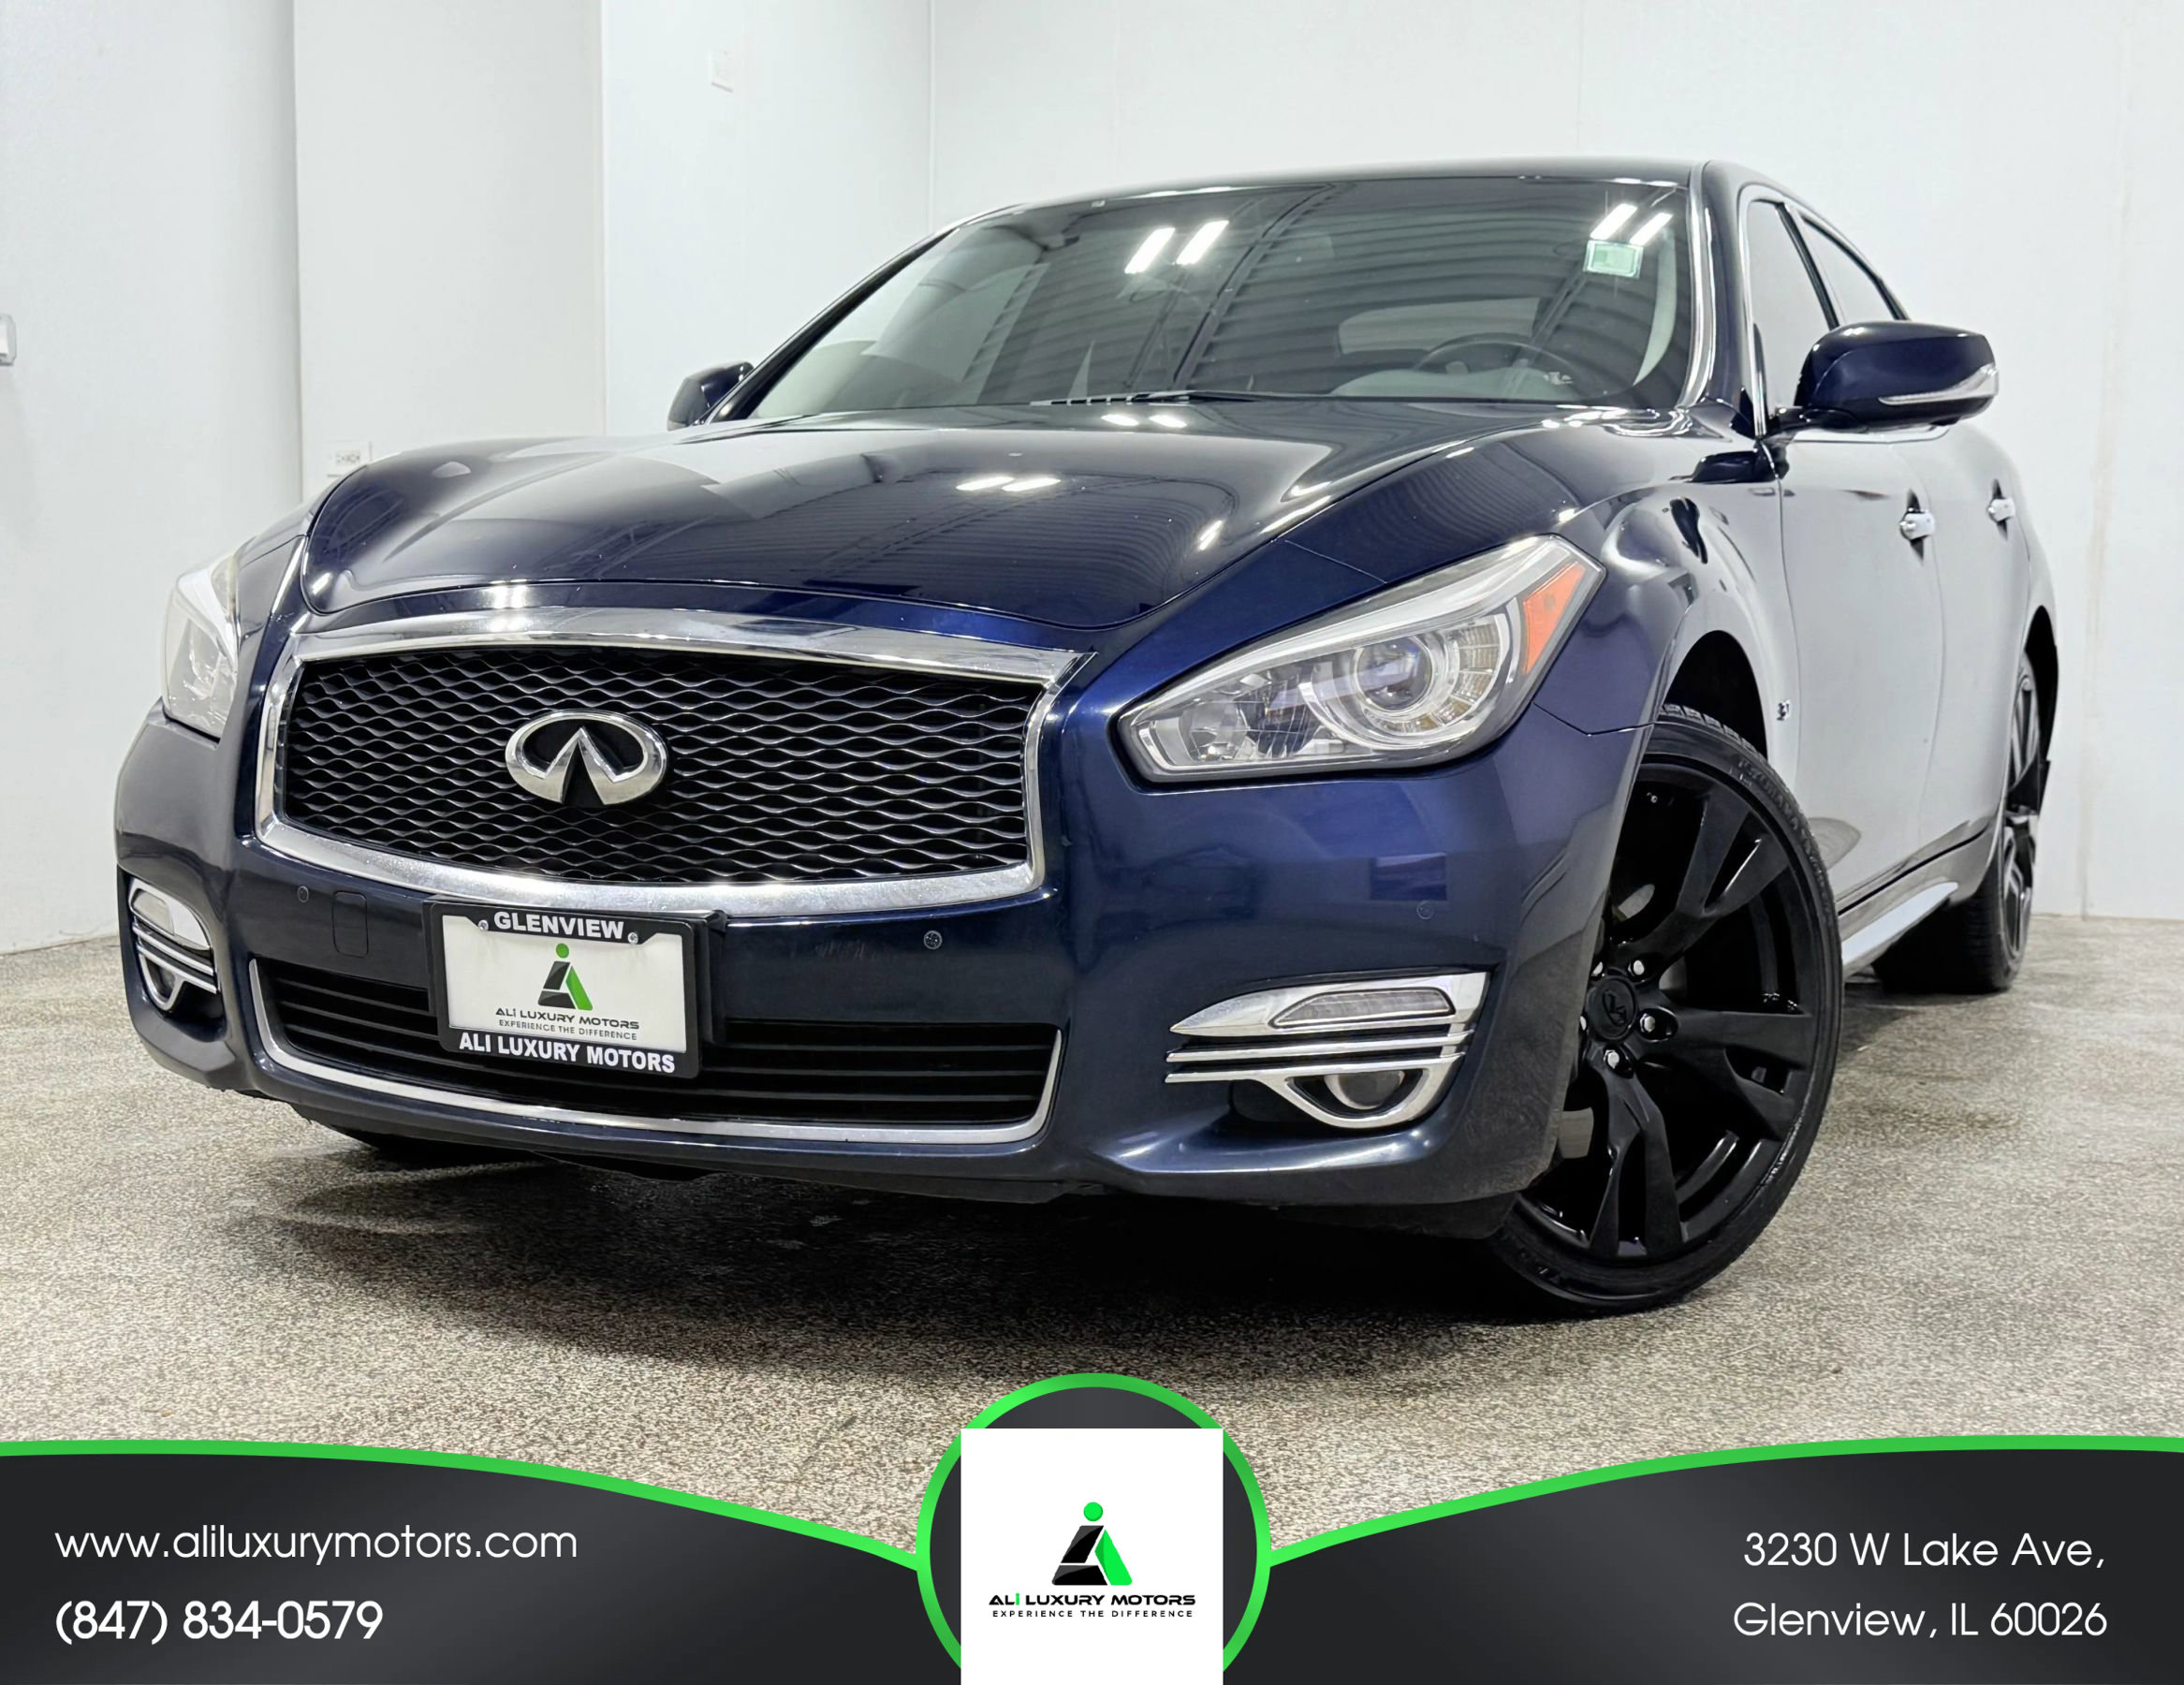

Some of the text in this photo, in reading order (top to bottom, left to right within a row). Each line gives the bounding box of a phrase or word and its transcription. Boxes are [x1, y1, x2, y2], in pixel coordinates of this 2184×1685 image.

[493, 911, 624, 939] GLENVIEW
[499, 1019, 638, 1041] EXPERIENCE THE DIFFERENCE
[520, 1010, 576, 1023] LUXURY
[579, 1017, 640, 1030] MOTORS
[459, 1032, 676, 1074] ALI LUXURY MOTORS
